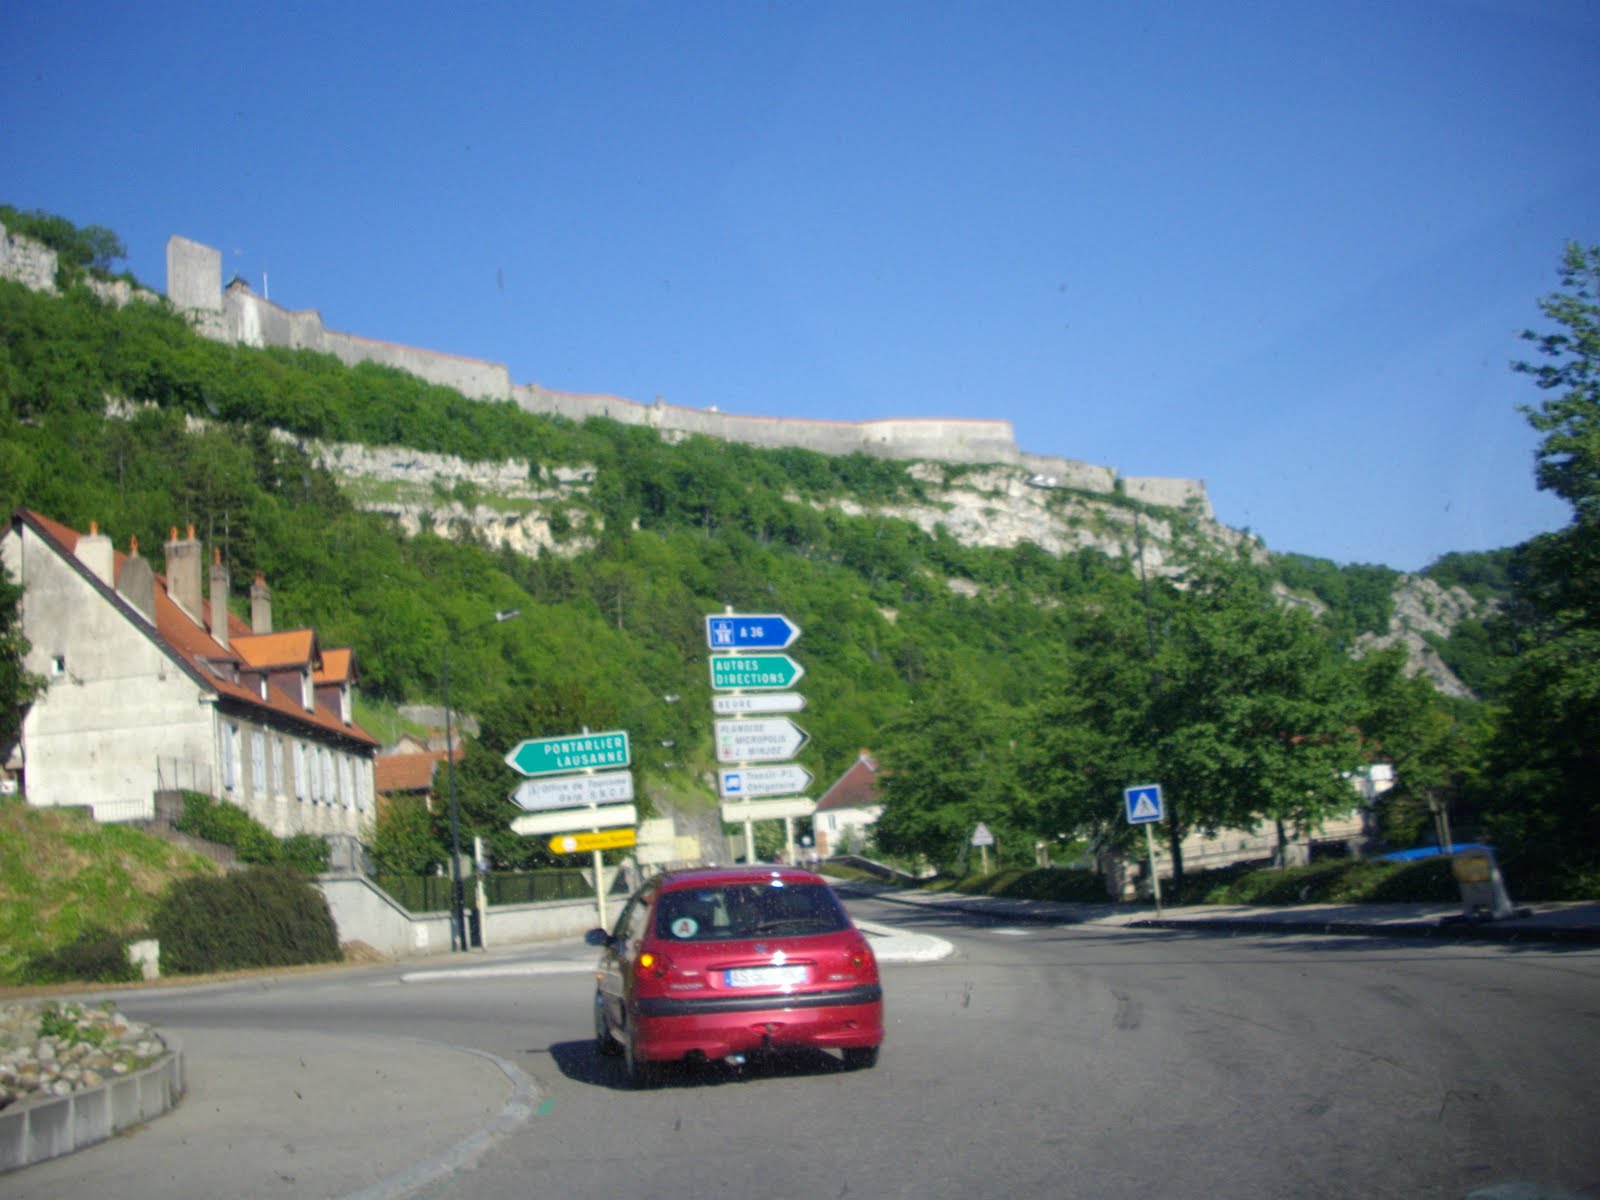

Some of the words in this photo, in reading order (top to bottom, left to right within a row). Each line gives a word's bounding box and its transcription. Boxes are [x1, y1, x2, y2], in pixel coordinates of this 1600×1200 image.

[740, 627, 748, 638] A
[750, 626, 764, 638] 36
[716, 660, 759, 671] AUTRES
[716, 673, 785, 685] DIRECTIONS
[544, 738, 622, 755] PONTARLIER
[556, 751, 623, 768] LAUSANNE
